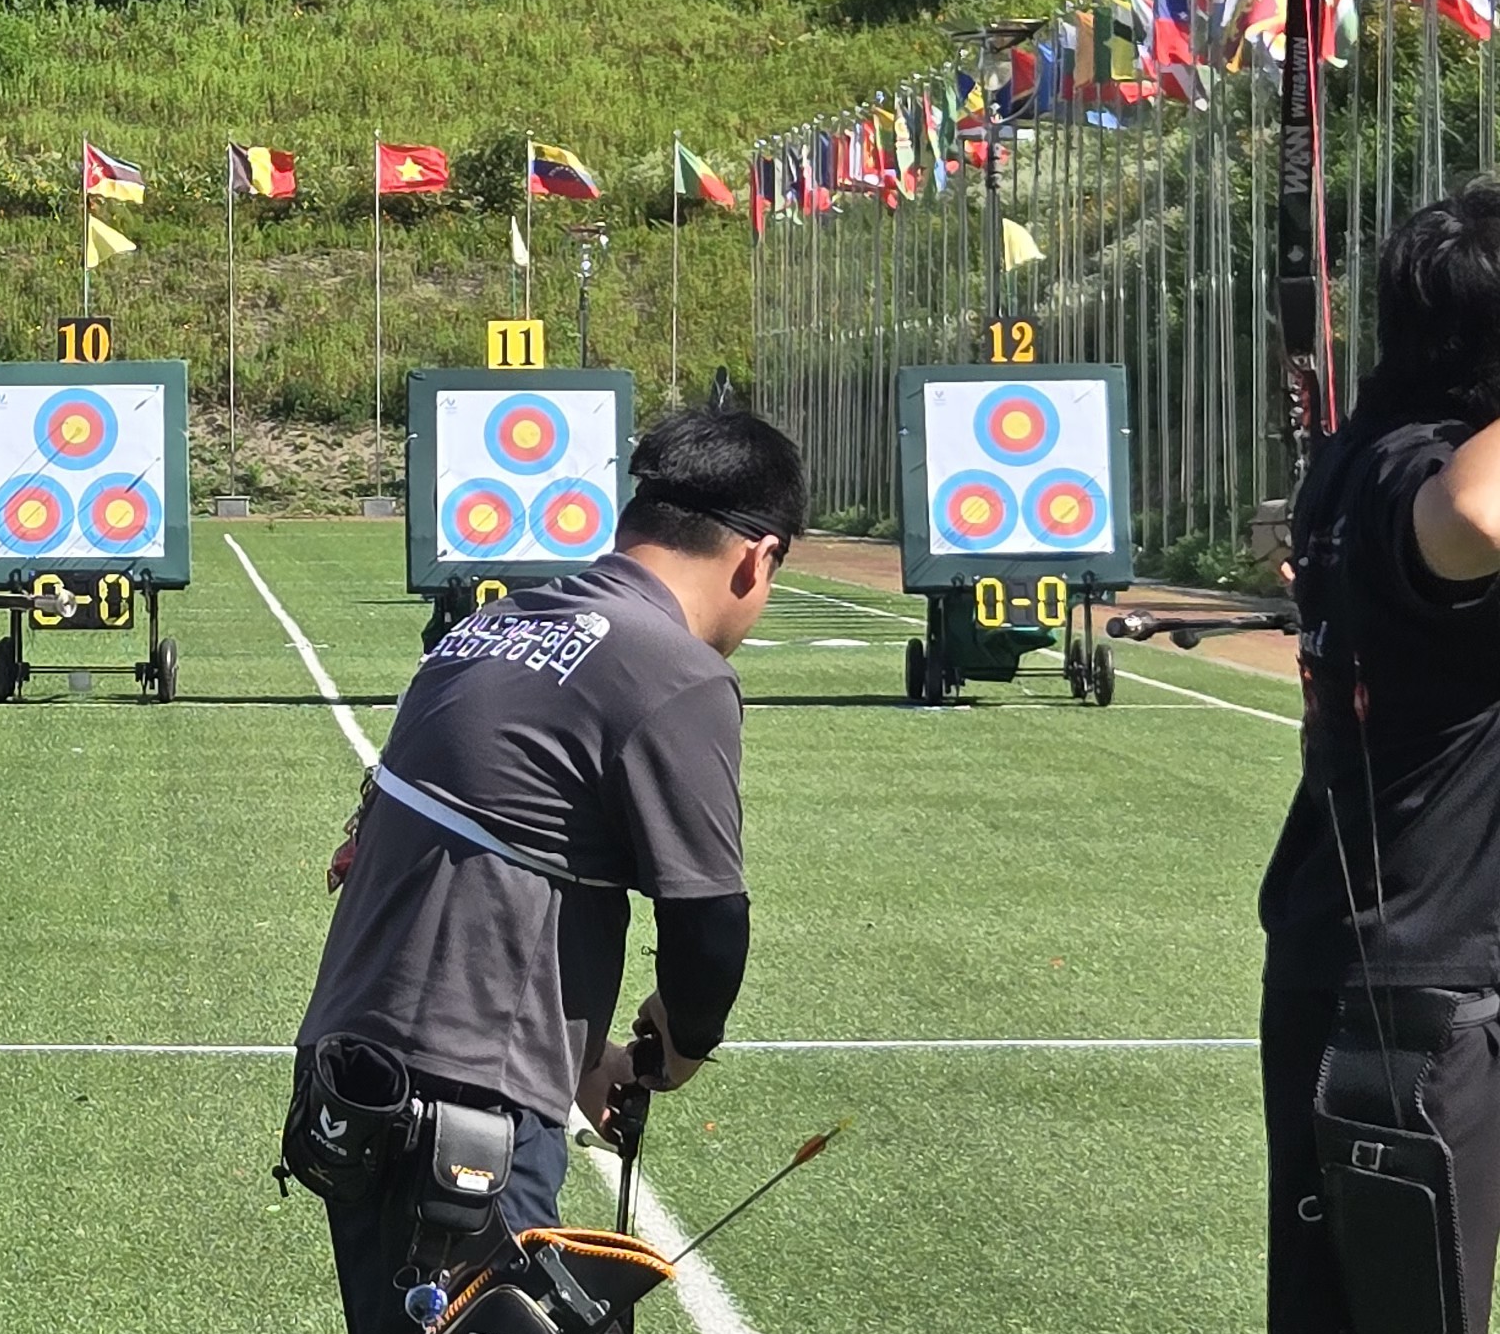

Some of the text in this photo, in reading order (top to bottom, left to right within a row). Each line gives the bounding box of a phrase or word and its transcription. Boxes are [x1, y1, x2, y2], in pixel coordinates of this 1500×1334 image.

[58, 323, 110, 364] 10
[496, 327, 536, 366] 11
[990, 321, 1034, 364] 12
[975, 575, 1067, 628] 0-0
